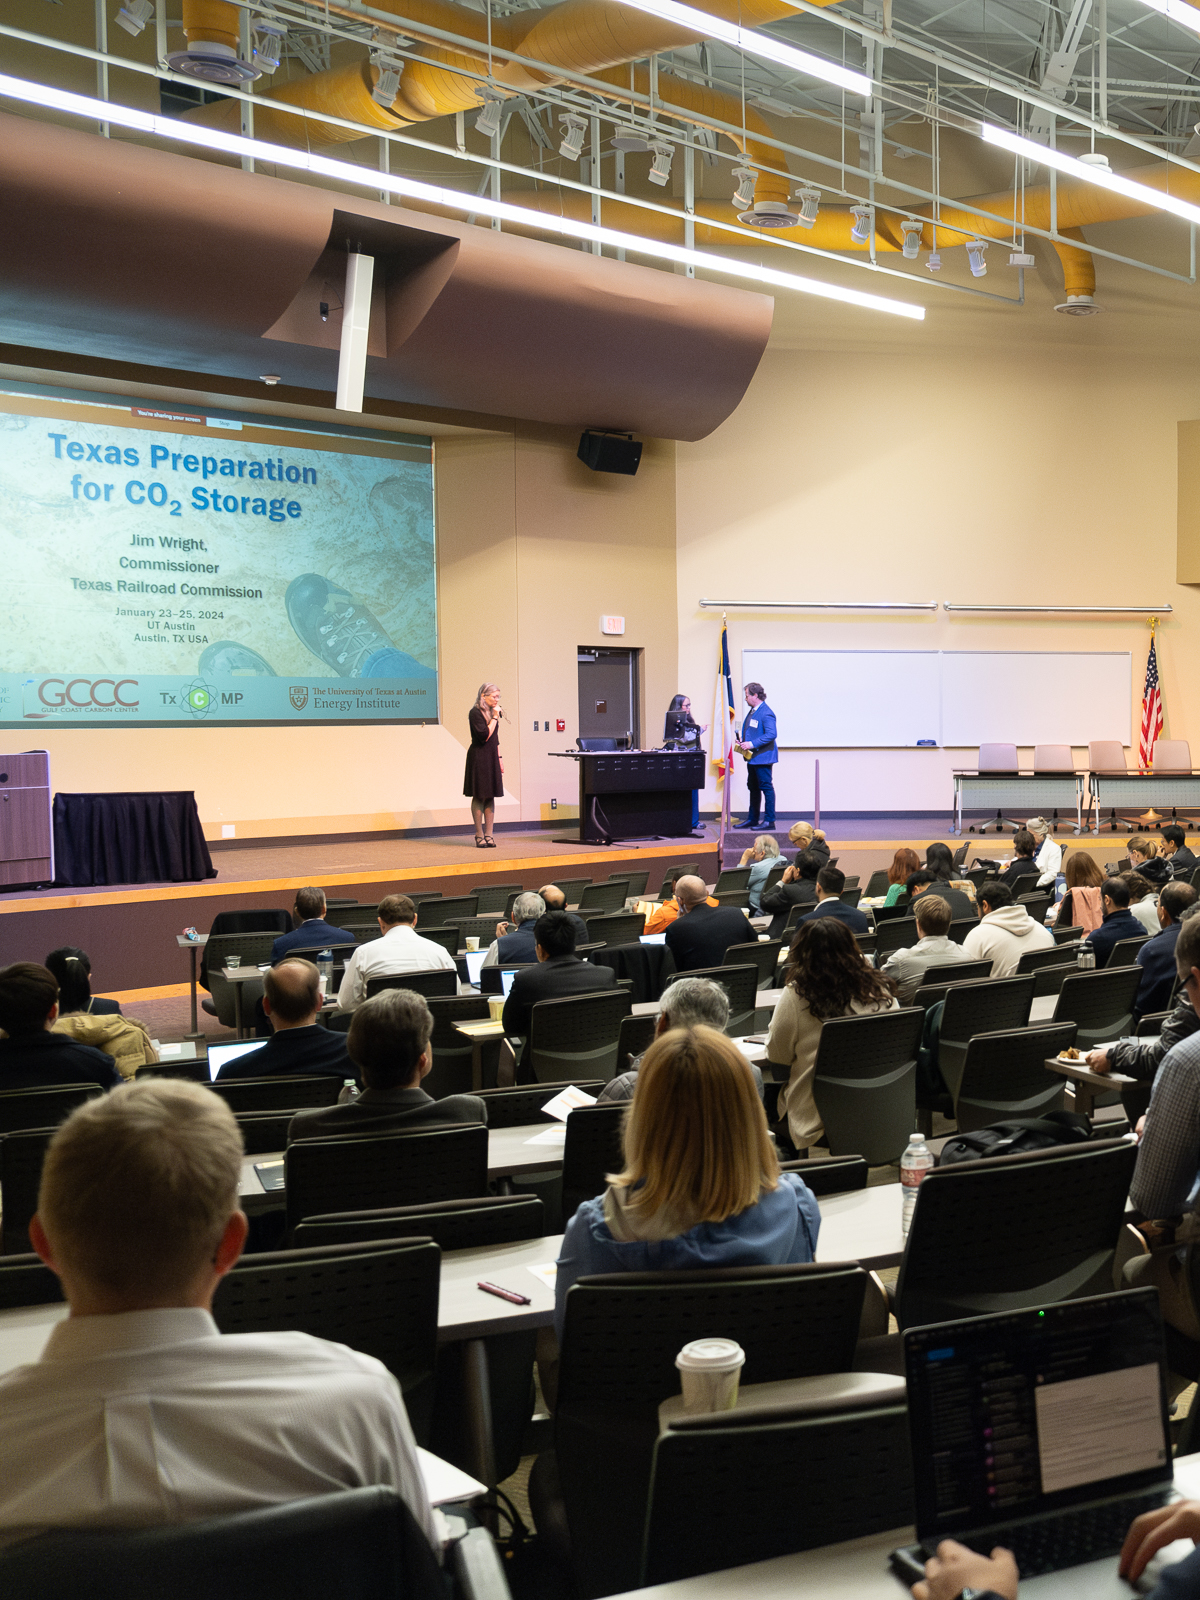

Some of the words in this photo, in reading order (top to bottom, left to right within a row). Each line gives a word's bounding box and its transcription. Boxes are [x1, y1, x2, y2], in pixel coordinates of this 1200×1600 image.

[154, 412, 172, 420] sharing
[48, 433, 140, 467] Texas
[151, 445, 317, 485] Preparation
[70, 474, 114, 502] for
[191, 486, 302, 522] Storage
[130, 534, 154, 546] Jim
[159, 536, 207, 552] Wright,
[119, 556, 219, 574] Commissioner
[70, 577, 112, 591] Texas
[117, 580, 176, 594] Railroad
[181, 583, 263, 598] Commission
[115, 607, 156, 618] January
[198, 610, 224, 619] 2024
[147, 621, 160, 629] UT
[163, 622, 195, 631] Austin
[172, 634, 185, 642] TX
[188, 635, 209, 643] USA
[38, 678, 139, 707] GCCC
[159, 692, 177, 705] Tx
[193, 692, 205, 706] C
[221, 692, 244, 705] MP
[312, 687, 326, 695] The
[328, 687, 365, 697] University
[366, 687, 374, 696] of
[375, 688, 395, 696] Texas
[396, 688, 403, 696] at
[404, 688, 427, 696] Austin
[313, 697, 353, 711] Energy
[356, 698, 401, 709] Institute
